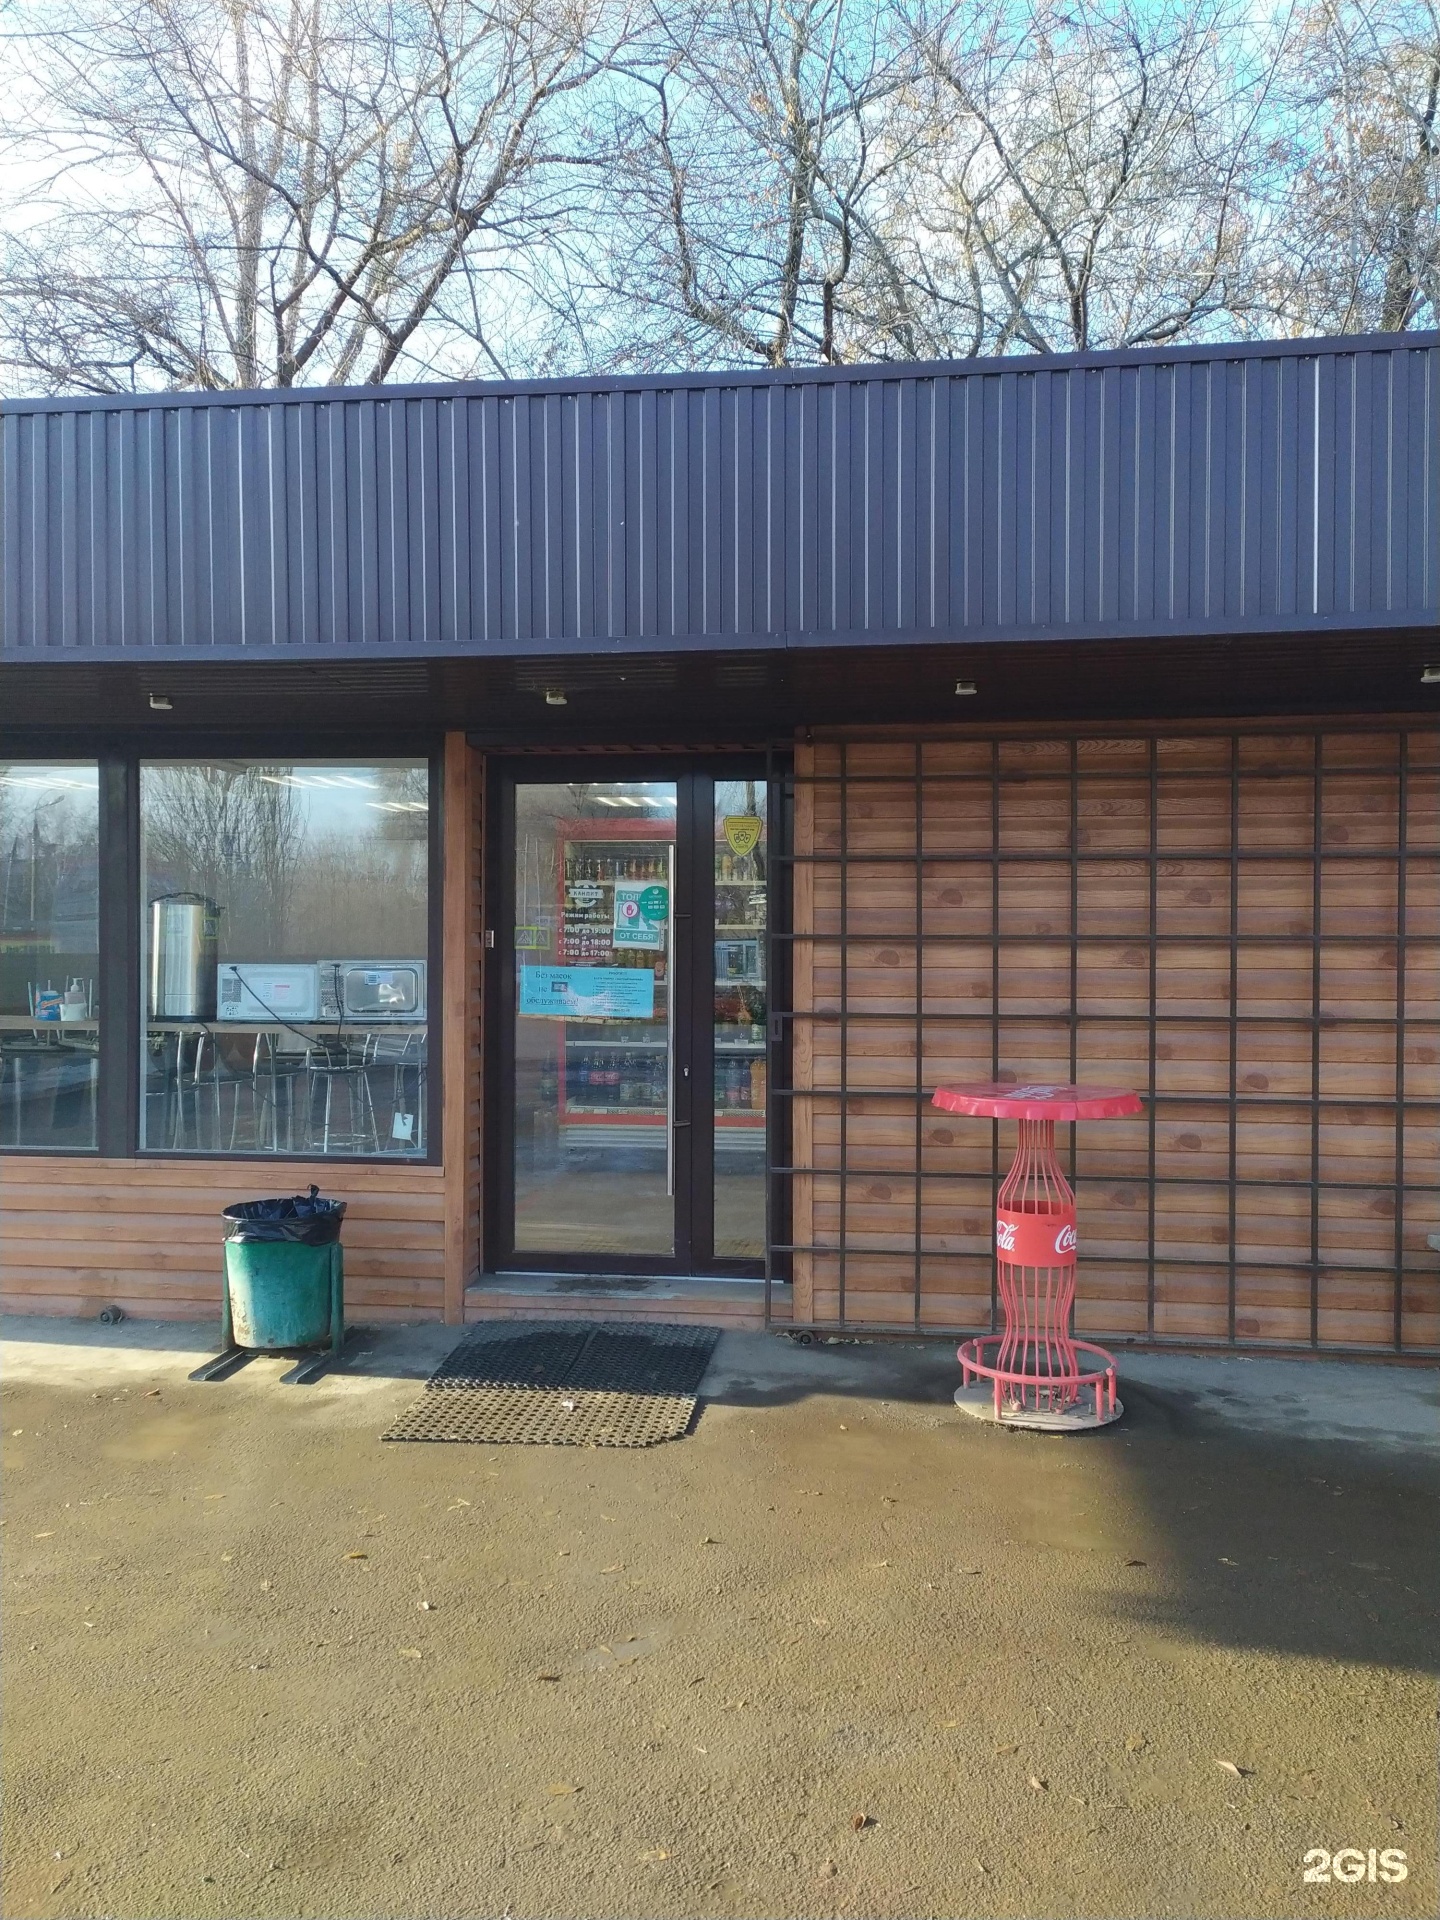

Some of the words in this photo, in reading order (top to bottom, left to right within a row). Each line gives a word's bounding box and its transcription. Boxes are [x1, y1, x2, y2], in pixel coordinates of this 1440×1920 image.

[632, 933, 654, 941] СЕБЯ
[590, 949, 610, 957] 17:00
[535, 970, 548, 979] Без
